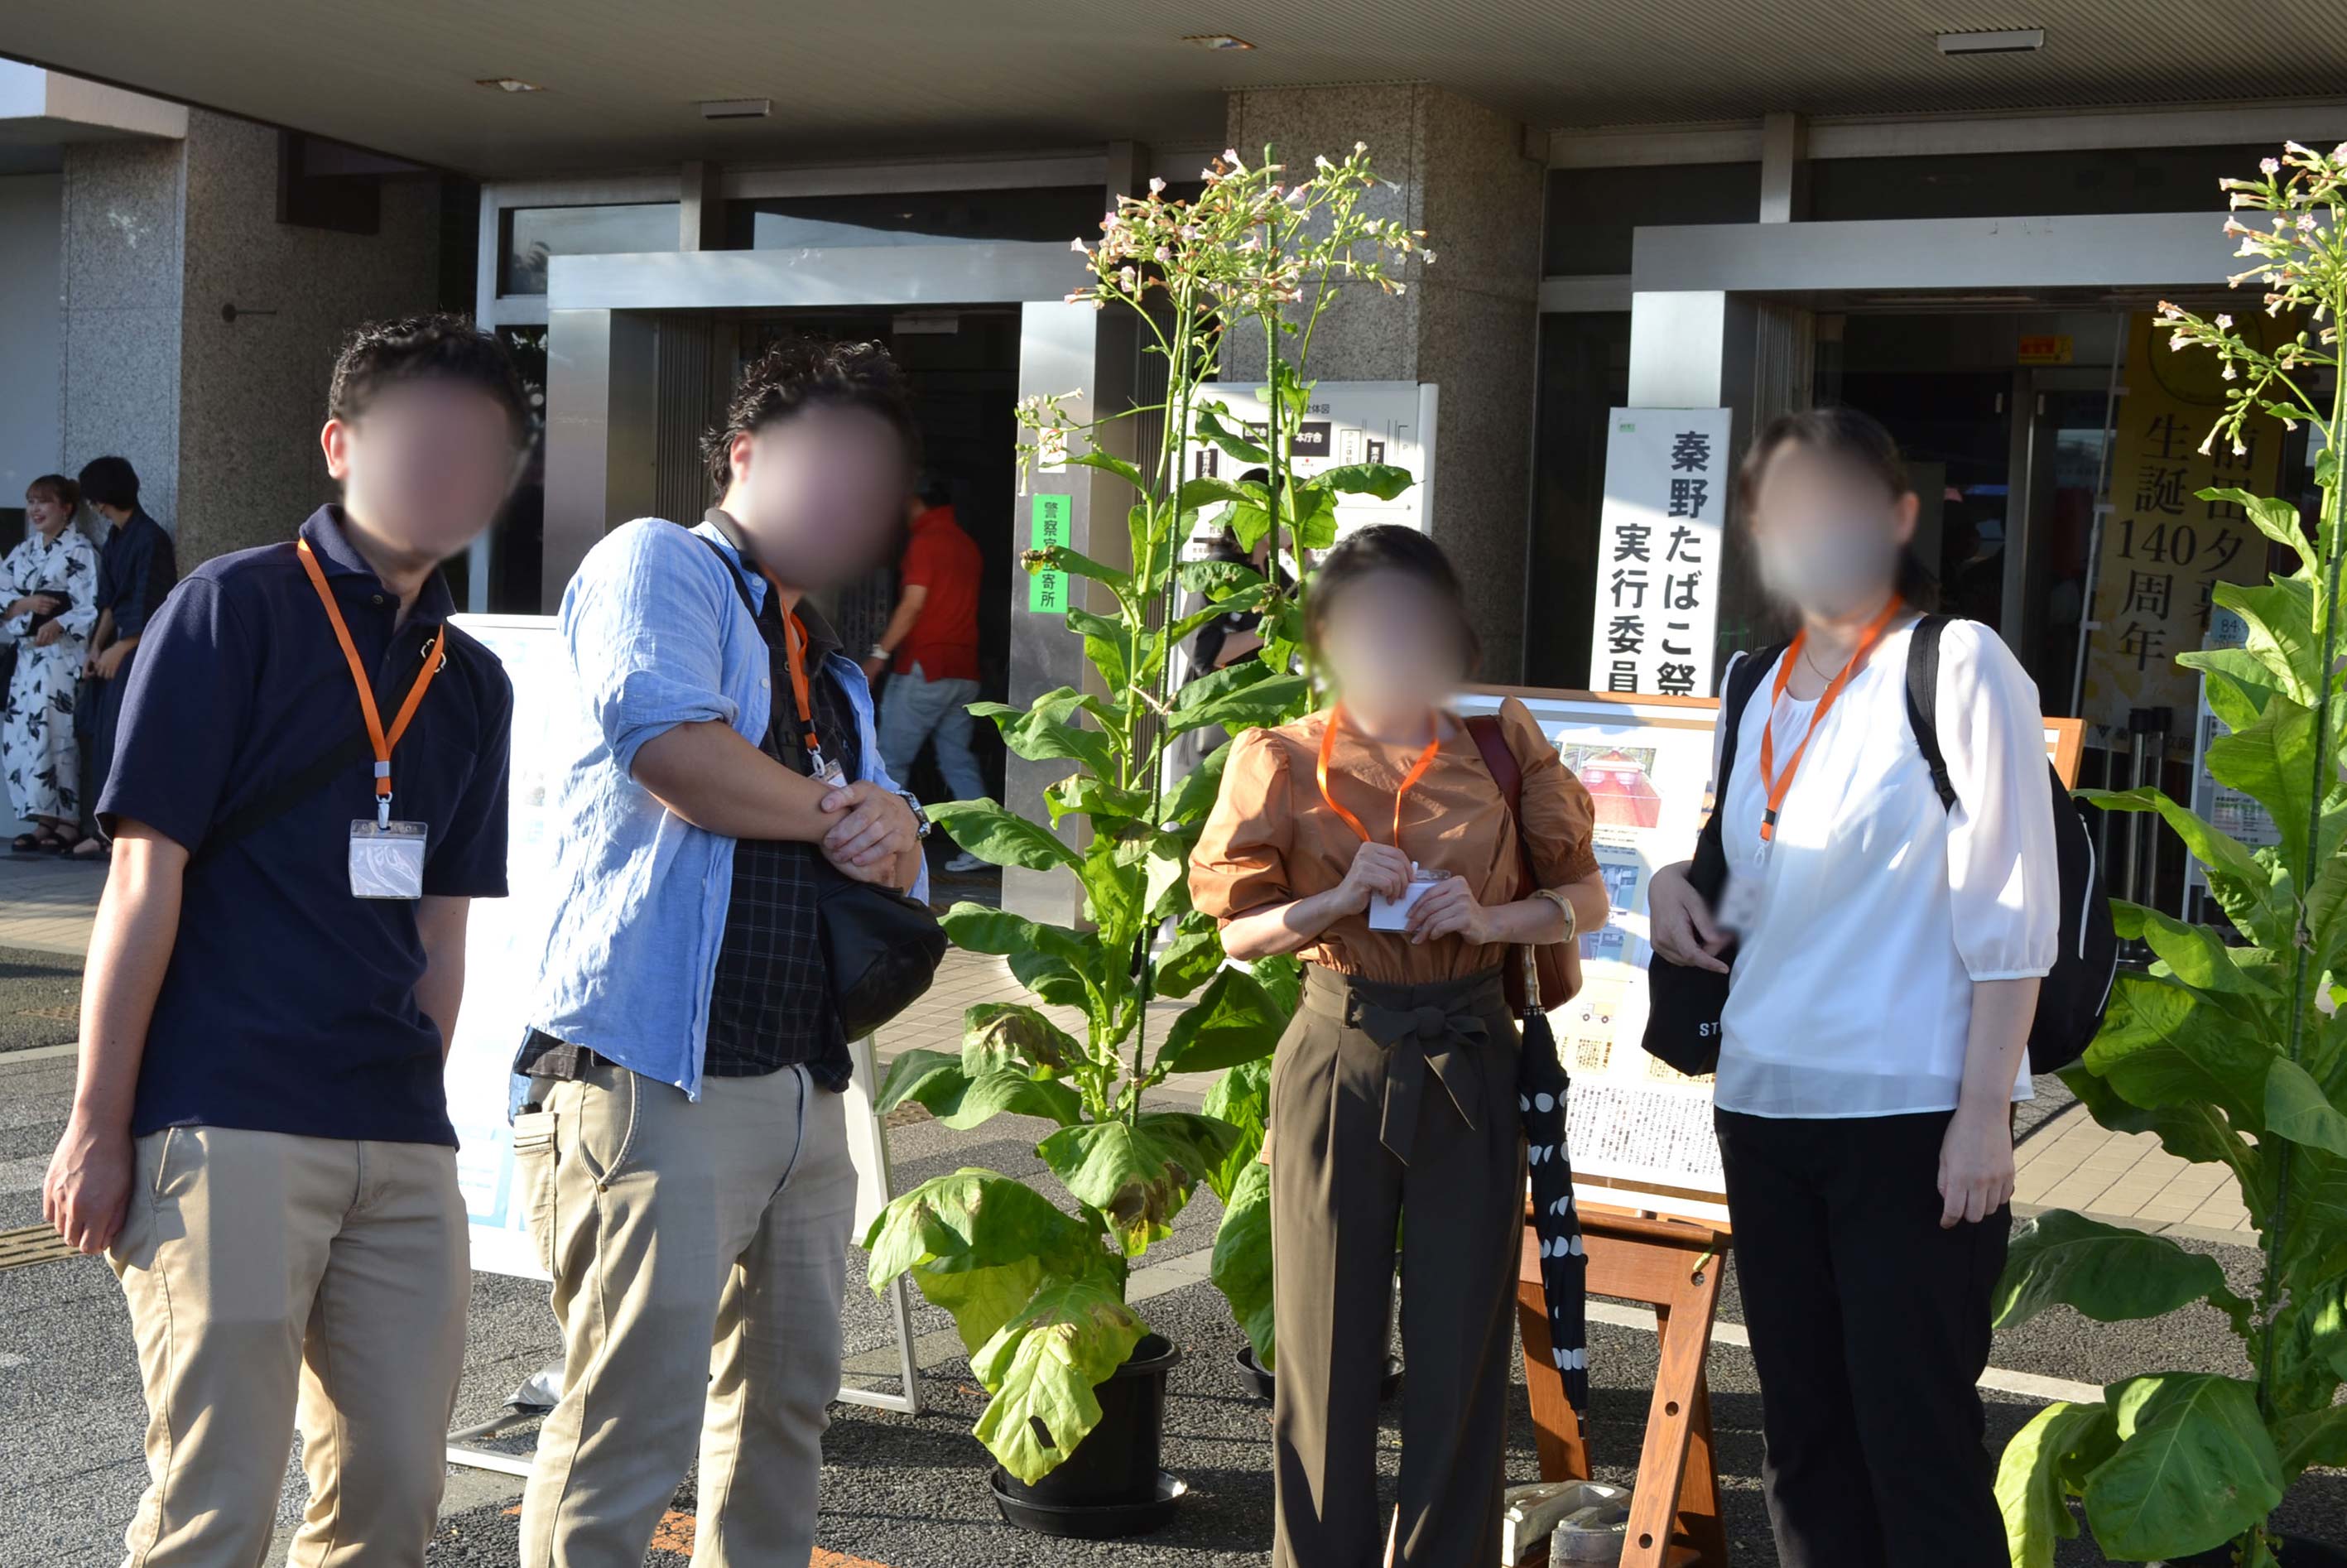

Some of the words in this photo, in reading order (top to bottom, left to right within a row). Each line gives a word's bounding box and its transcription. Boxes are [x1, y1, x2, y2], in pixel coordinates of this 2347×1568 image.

[1607, 522, 1652, 693] 実行委員
[1656, 430, 1711, 696] 秦野たばこ祭
[2116, 412, 2196, 672] 生誕140周年
[2192, 422, 2258, 631] 前田夕
